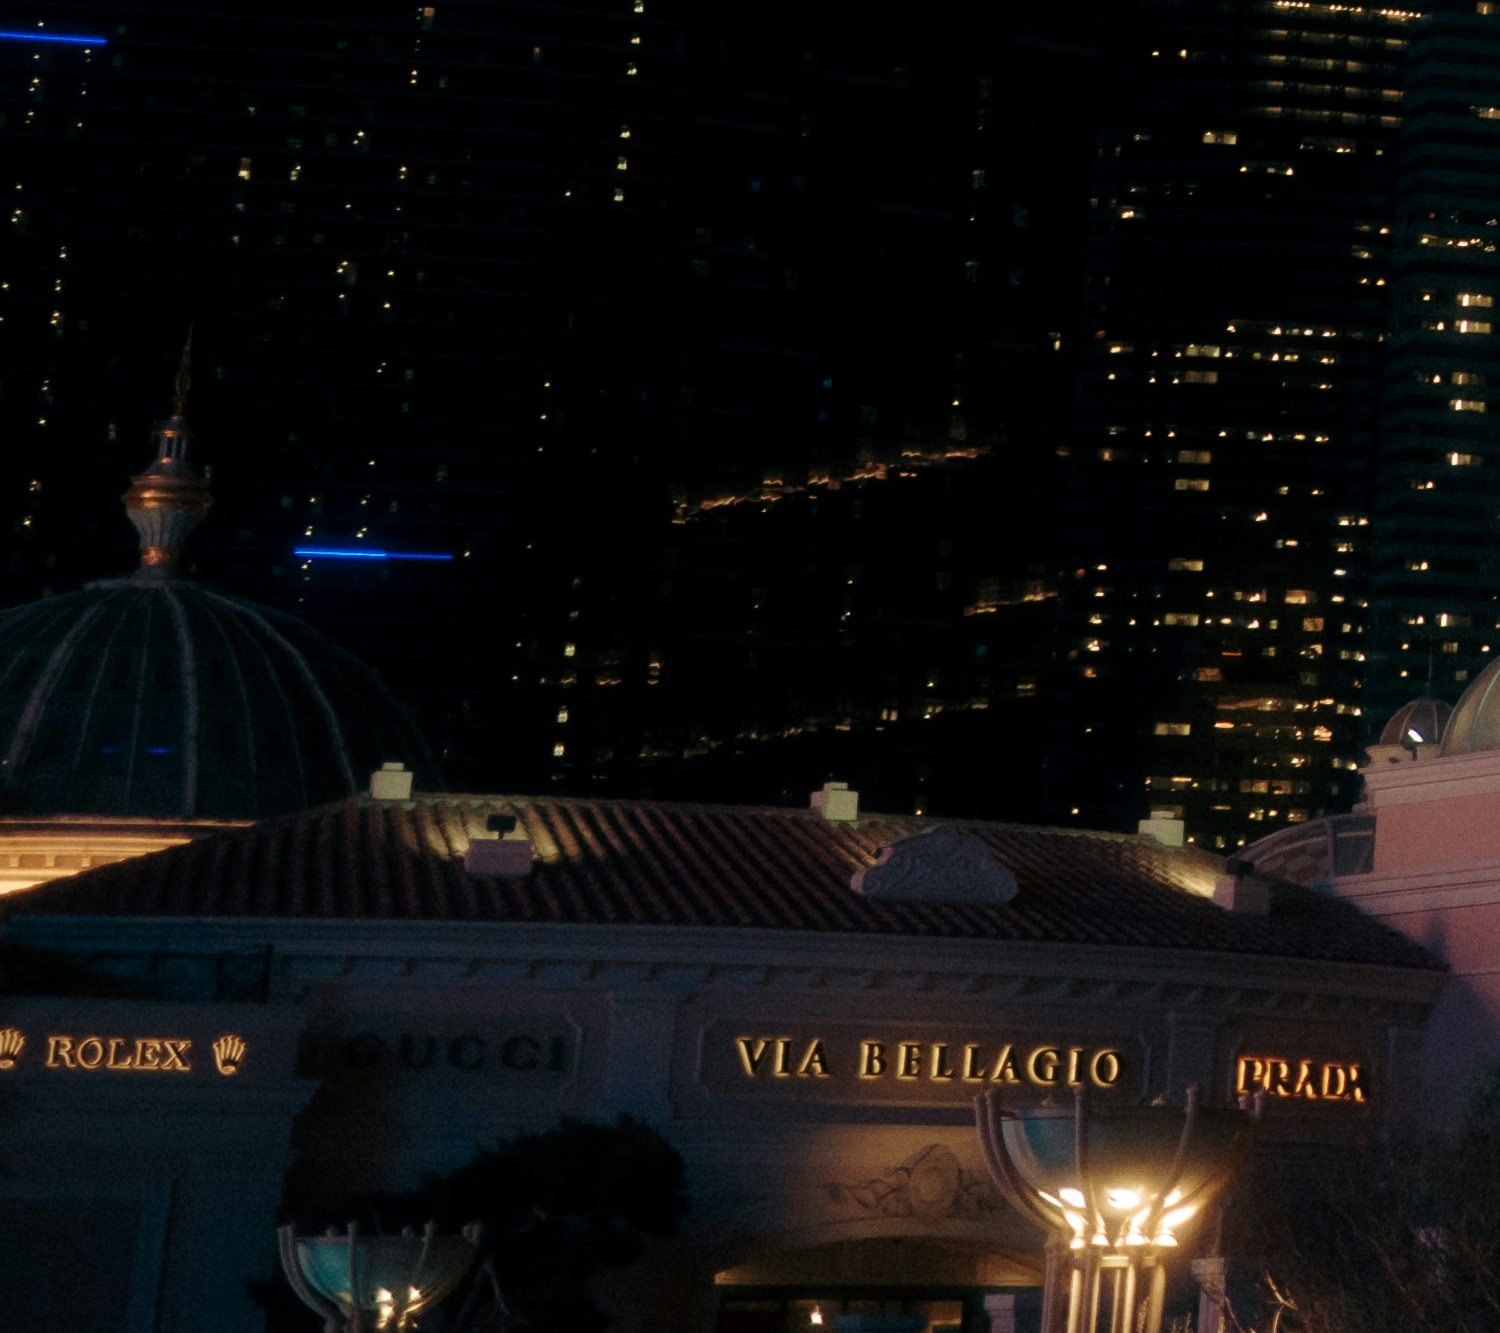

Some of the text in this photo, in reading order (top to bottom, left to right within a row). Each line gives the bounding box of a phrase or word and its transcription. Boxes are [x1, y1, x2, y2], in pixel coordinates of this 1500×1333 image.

[46, 1035, 192, 1071] ROLEX
[736, 1037, 1122, 1087] VIA BELLAGIO
